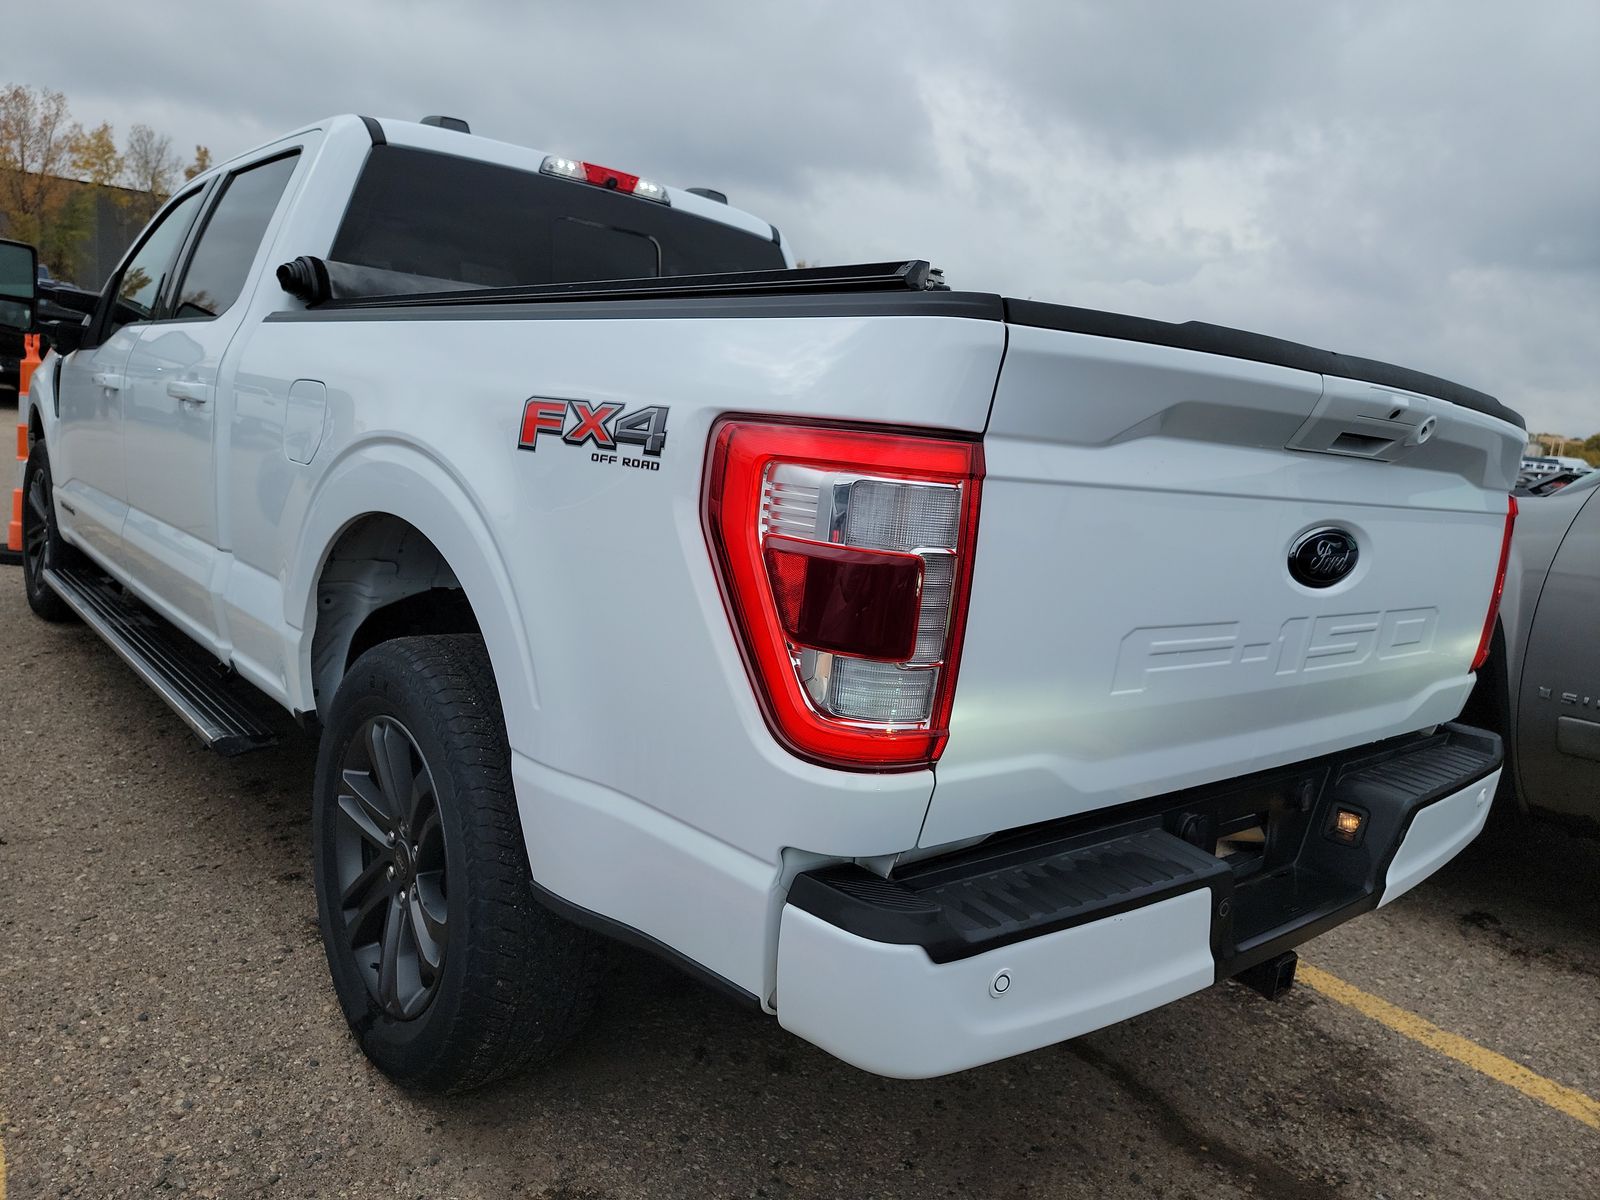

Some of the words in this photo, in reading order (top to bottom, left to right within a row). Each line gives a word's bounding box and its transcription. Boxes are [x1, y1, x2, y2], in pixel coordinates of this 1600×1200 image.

[518, 396, 670, 457] FX4
[591, 453, 618, 464] OFF
[622, 457, 660, 471] ROAD
[1310, 540, 1351, 575] Ford
[1110, 605, 1440, 695] F-150
